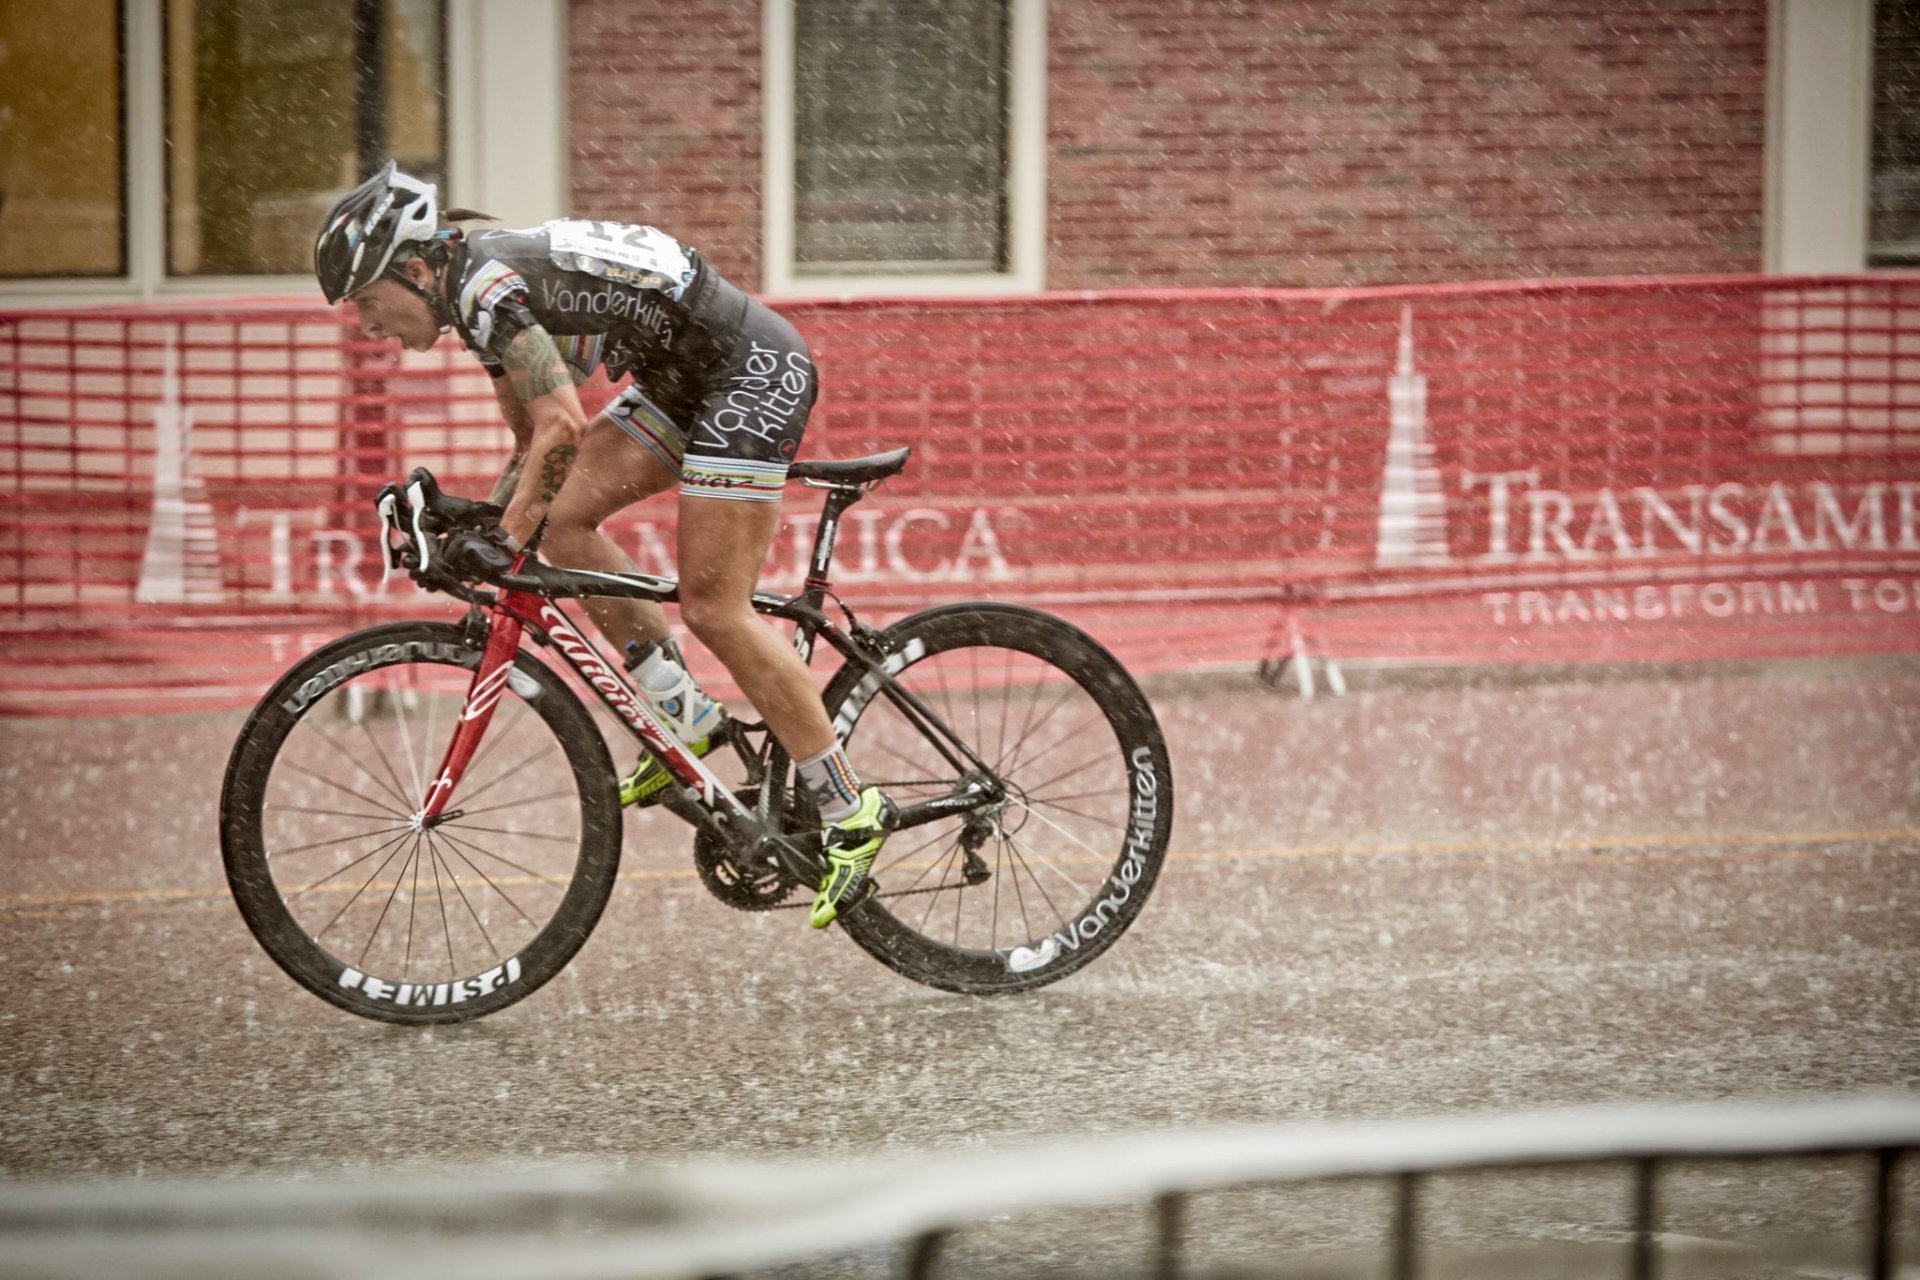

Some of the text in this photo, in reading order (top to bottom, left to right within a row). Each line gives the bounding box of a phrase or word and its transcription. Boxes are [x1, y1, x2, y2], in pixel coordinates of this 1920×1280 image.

[541, 277, 673, 350] Vanderkitt
[693, 340, 779, 449] Vander
[739, 351, 811, 443] kitten
[1841, 578, 1920, 614] TO
[540, 605, 655, 738] Wilier
[1055, 745, 1158, 953] Vanderkitten
